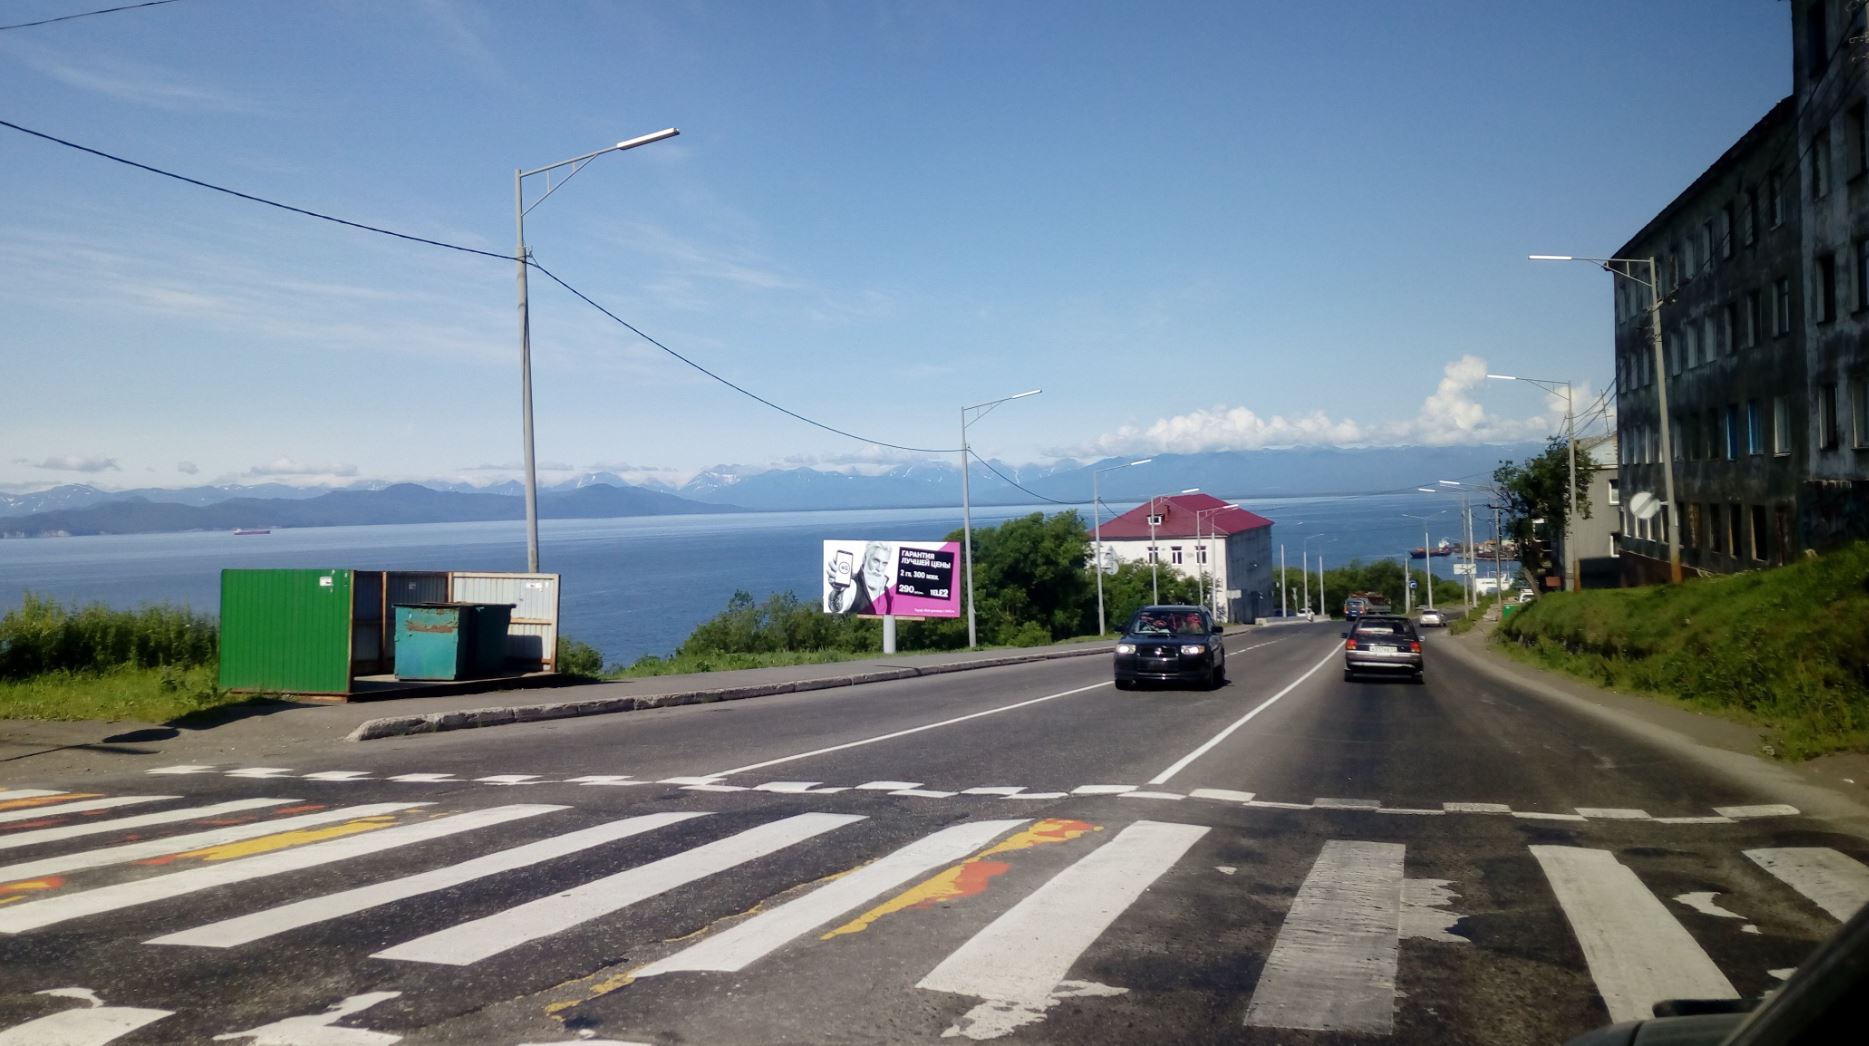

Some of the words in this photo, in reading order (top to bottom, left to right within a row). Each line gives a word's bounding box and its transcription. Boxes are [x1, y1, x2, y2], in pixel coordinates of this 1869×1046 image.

[901, 550, 935, 560] ГАРАНТИЯ
[901, 557, 930, 567] ЛУЧШЕЙ
[931, 561, 951, 569] ЦЕНЫ
[900, 569, 905, 577] 2
[913, 571, 926, 579] 300
[899, 584, 915, 593] 290
[930, 589, 949, 598] TELE2
